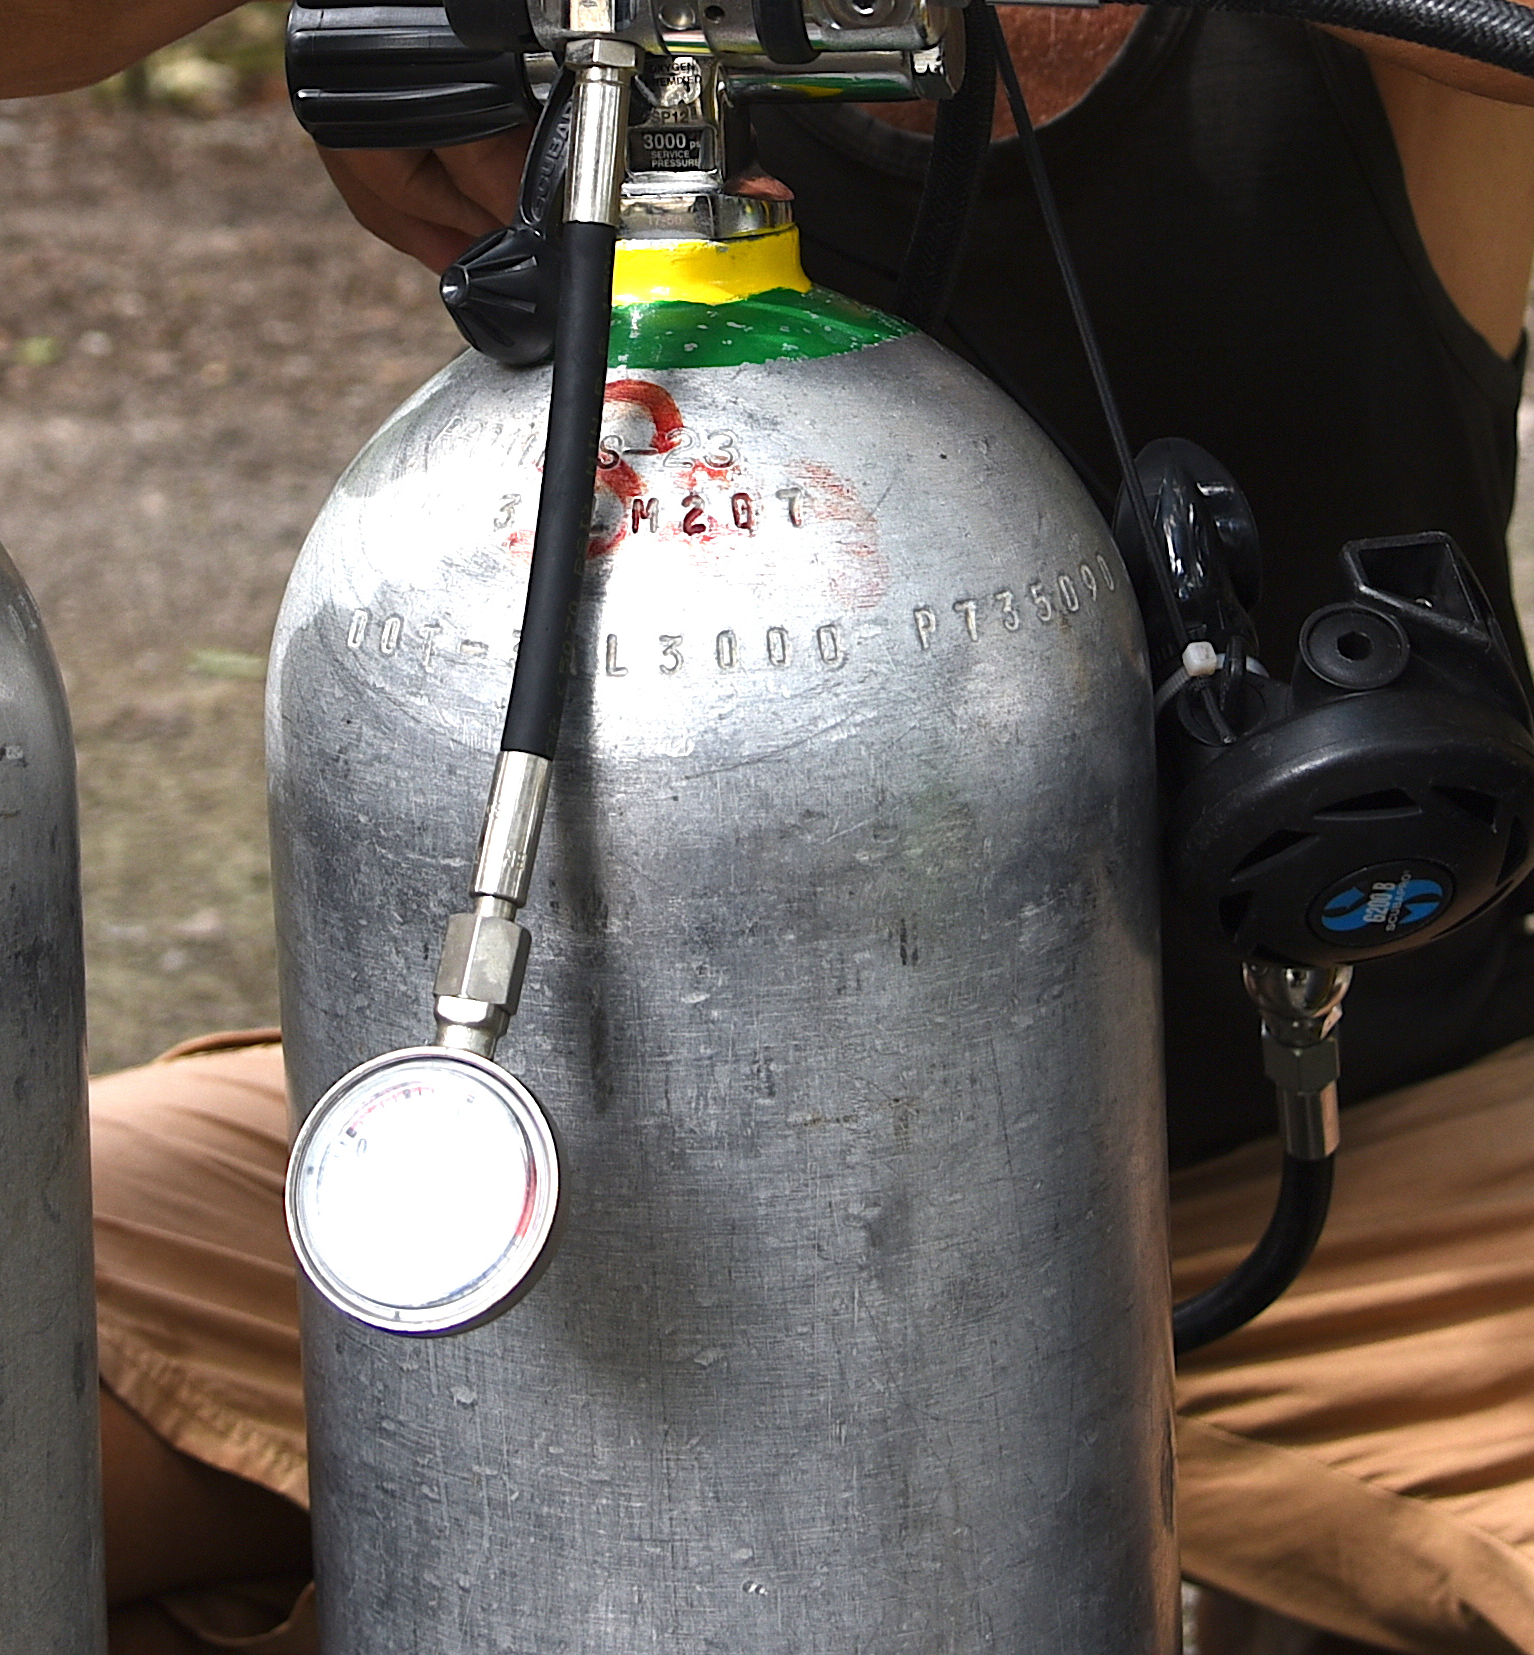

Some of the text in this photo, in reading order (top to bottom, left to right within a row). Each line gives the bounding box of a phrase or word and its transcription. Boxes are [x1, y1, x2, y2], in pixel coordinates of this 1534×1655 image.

[643, 133, 687, 150] 3000
[1362, 881, 1396, 923] G200 B
